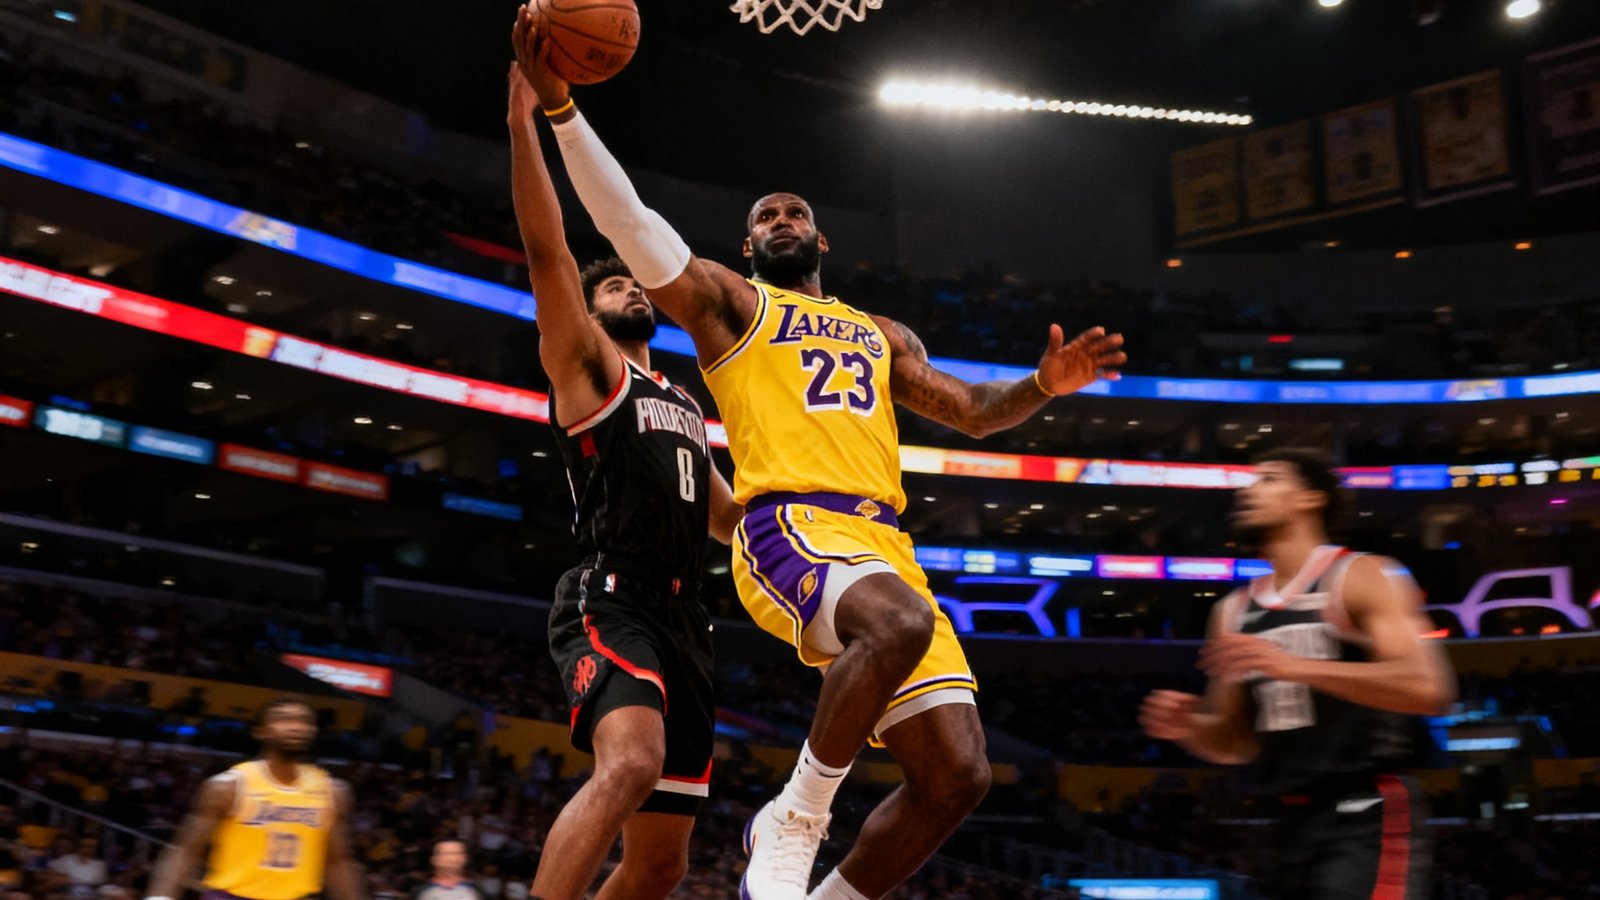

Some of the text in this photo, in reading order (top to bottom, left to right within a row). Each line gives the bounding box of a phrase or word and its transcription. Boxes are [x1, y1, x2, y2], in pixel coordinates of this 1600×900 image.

[769, 304, 883, 358] LAKERS
[800, 348, 876, 417] 23
[677, 447, 695, 502] 8
